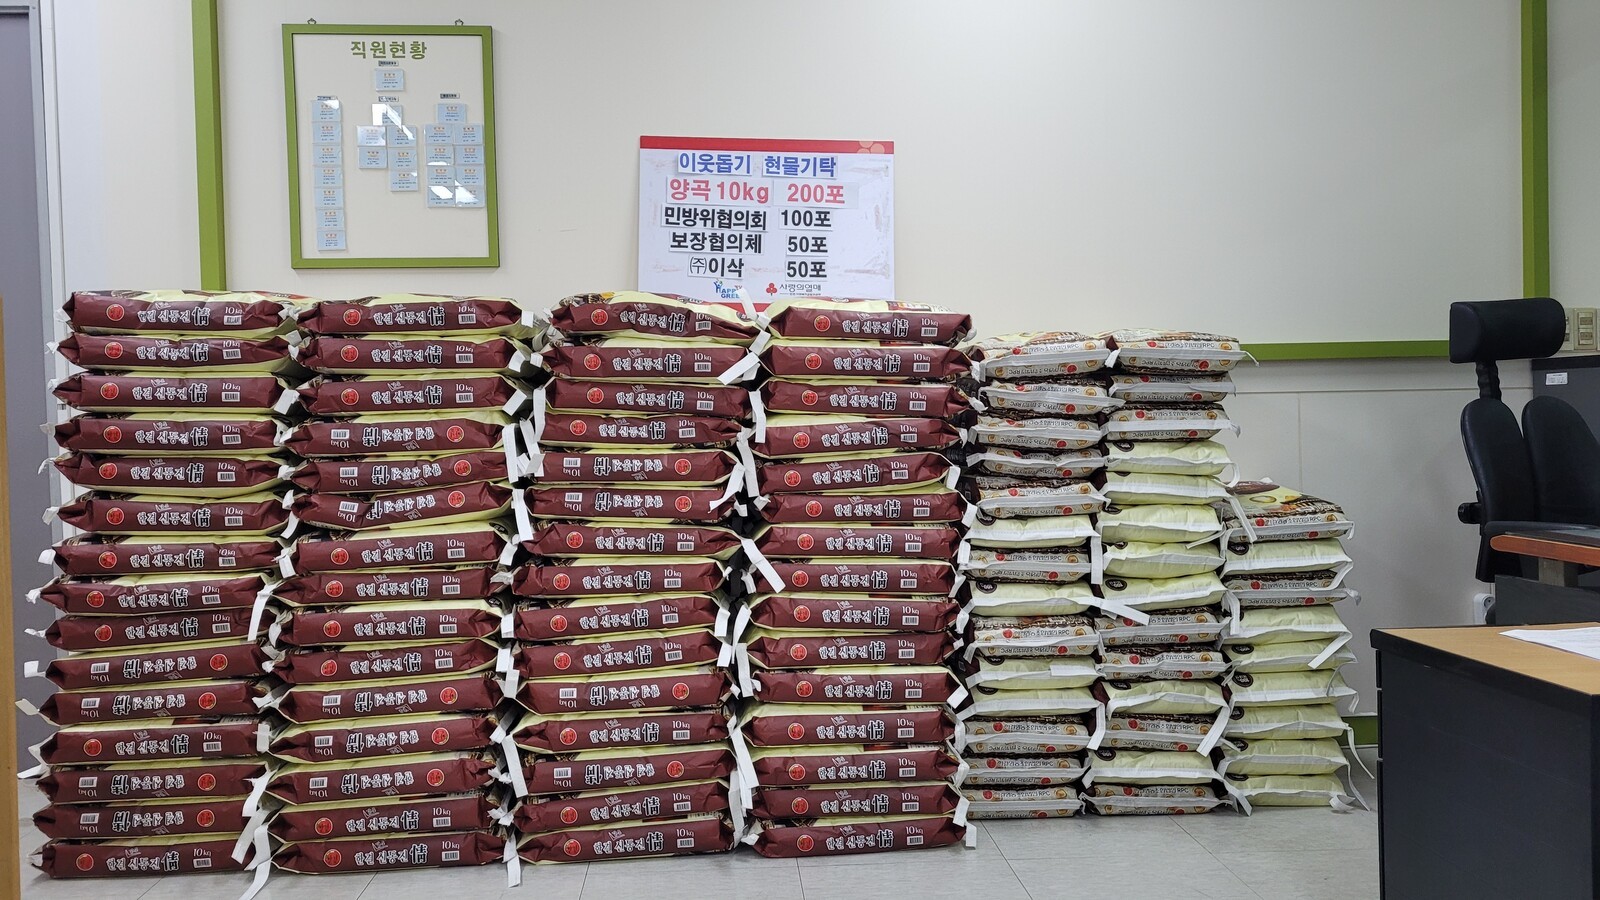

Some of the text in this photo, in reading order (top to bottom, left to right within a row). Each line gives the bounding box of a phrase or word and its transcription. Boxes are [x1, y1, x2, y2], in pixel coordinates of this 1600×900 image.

[350, 40, 427, 60] 직원현황
[679, 152, 836, 177] 이웃돕기 현물기탁
[670, 178, 846, 204] 양곡 10kg 200포
[664, 206, 832, 230] 민방위협의회 100포
[670, 232, 828, 254] 보장협의체 50포
[787, 261, 828, 278] 50포
